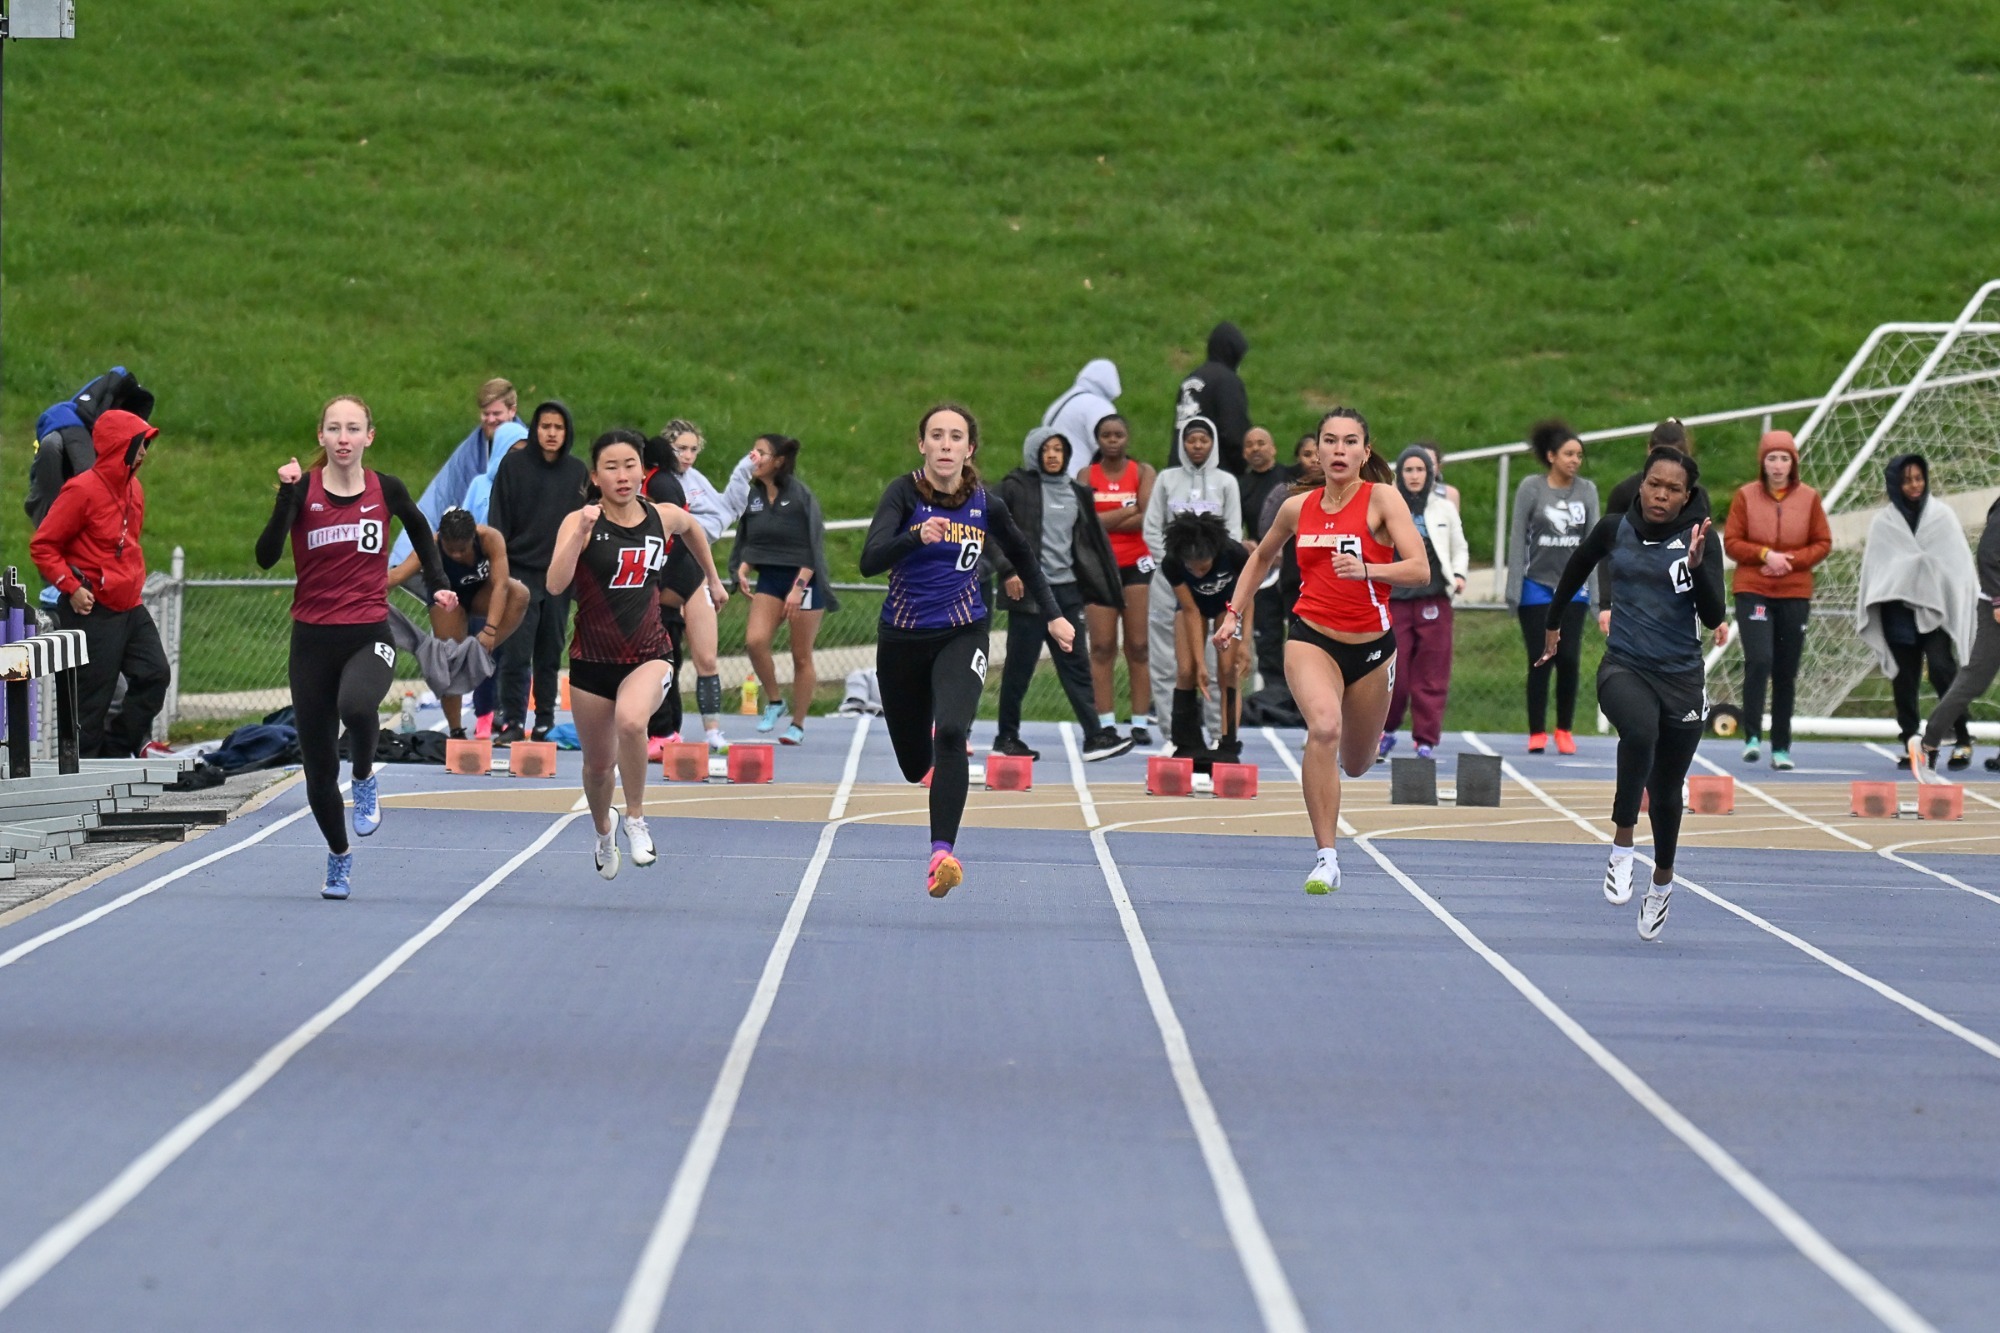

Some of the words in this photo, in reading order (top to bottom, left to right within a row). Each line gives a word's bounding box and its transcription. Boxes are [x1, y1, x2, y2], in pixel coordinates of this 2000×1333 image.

[361, 522, 379, 550] 8
[1340, 540, 1357, 559] 5
[648, 539, 661, 566] 7
[961, 542, 979, 569] 6
[609, 547, 649, 588] H
[1676, 561, 1691, 588] 4
[380, 644, 393, 662] 8
